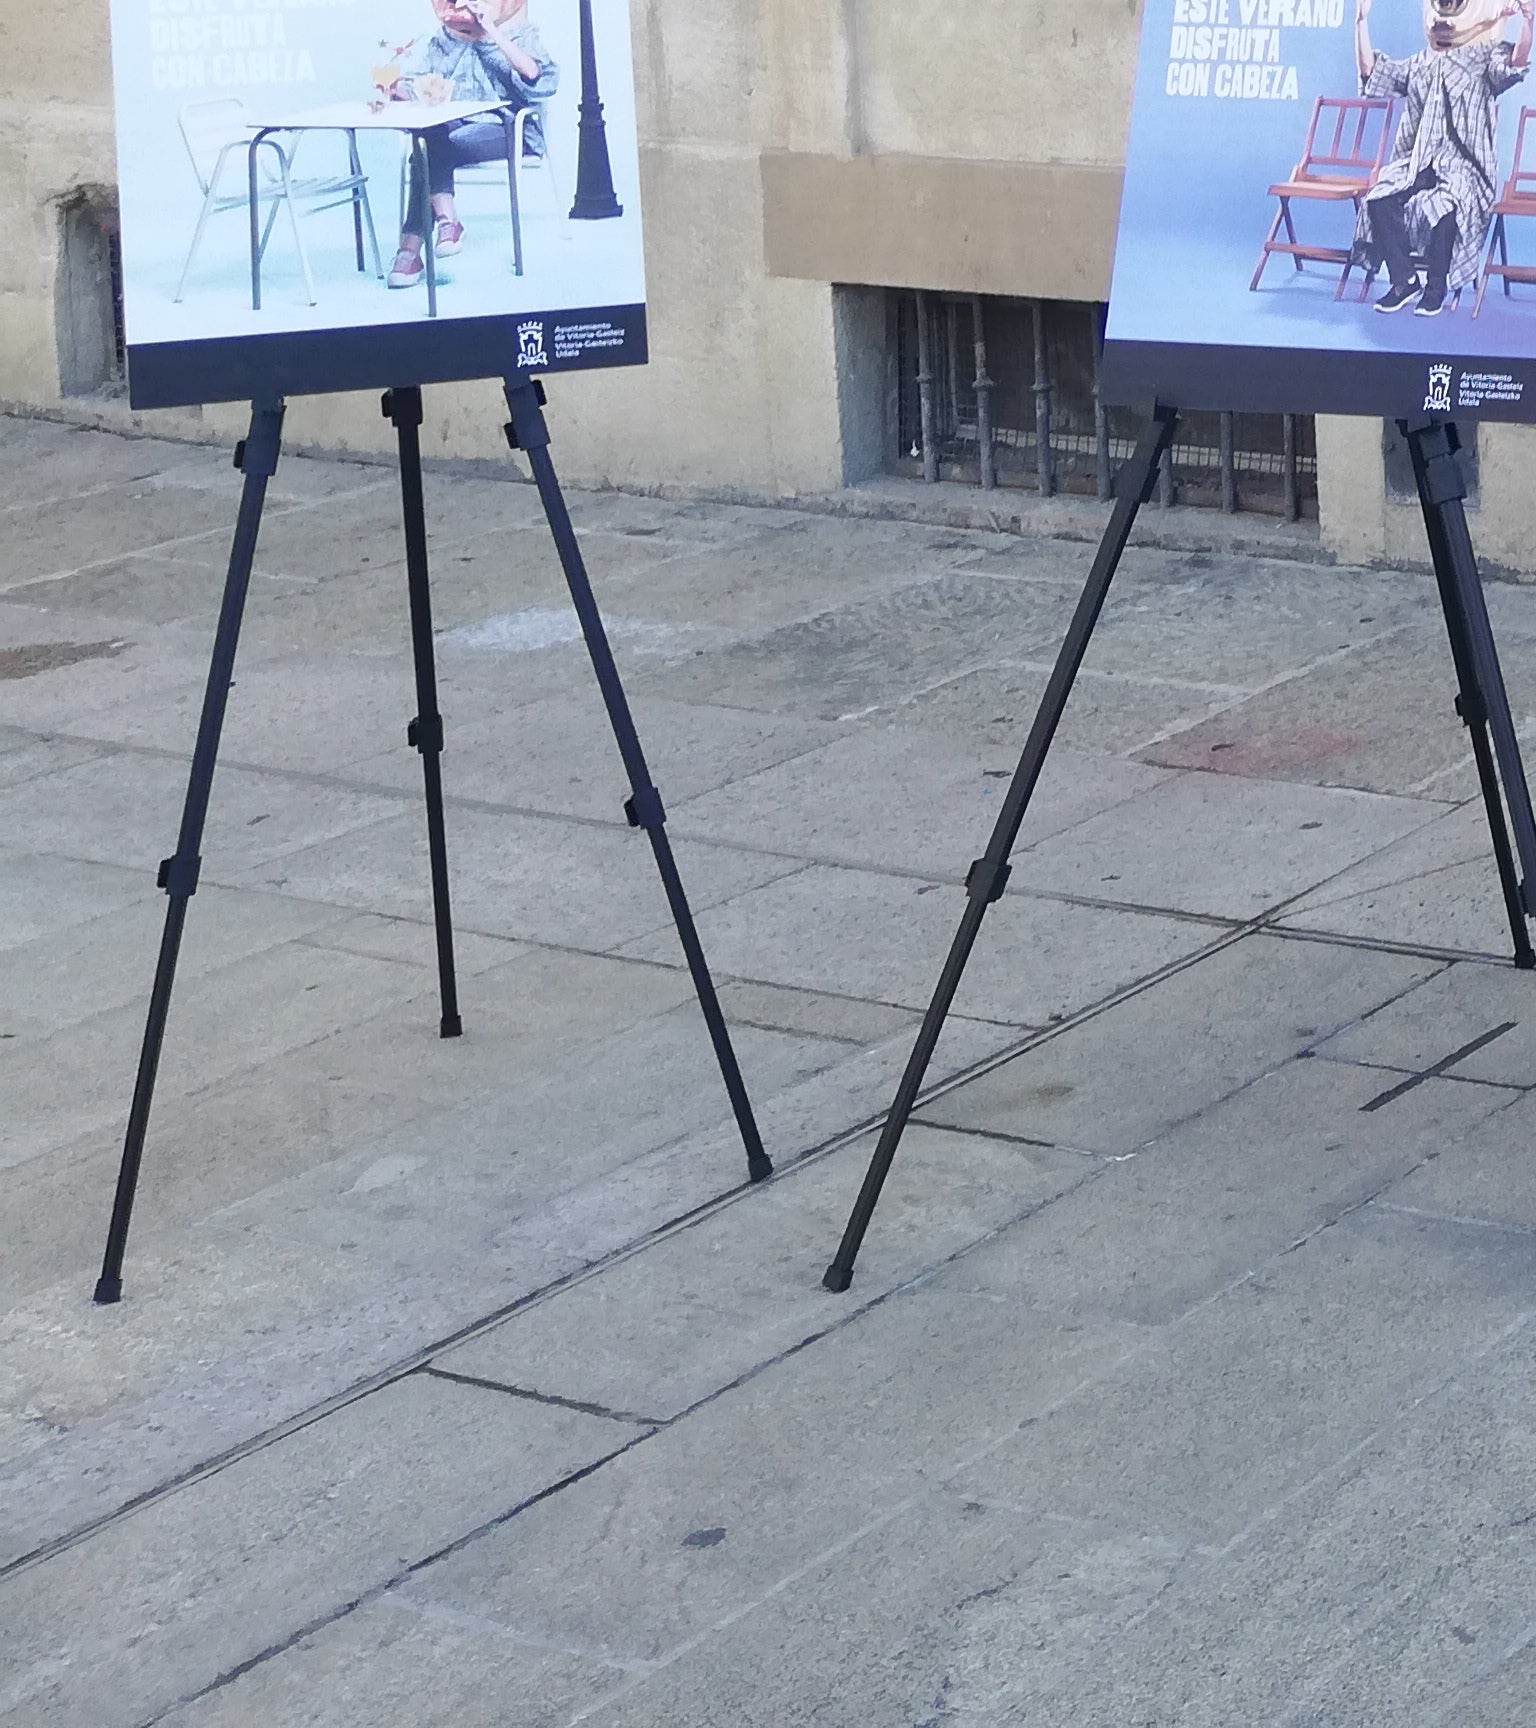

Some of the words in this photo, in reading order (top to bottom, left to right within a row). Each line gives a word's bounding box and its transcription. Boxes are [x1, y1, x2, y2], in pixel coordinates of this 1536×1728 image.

[1170, 25, 1279, 62] DISFRUTA
[151, 54, 205, 89] CON
[1166, 62, 1210, 97] CON
[1214, 64, 1298, 100] CABEZA
